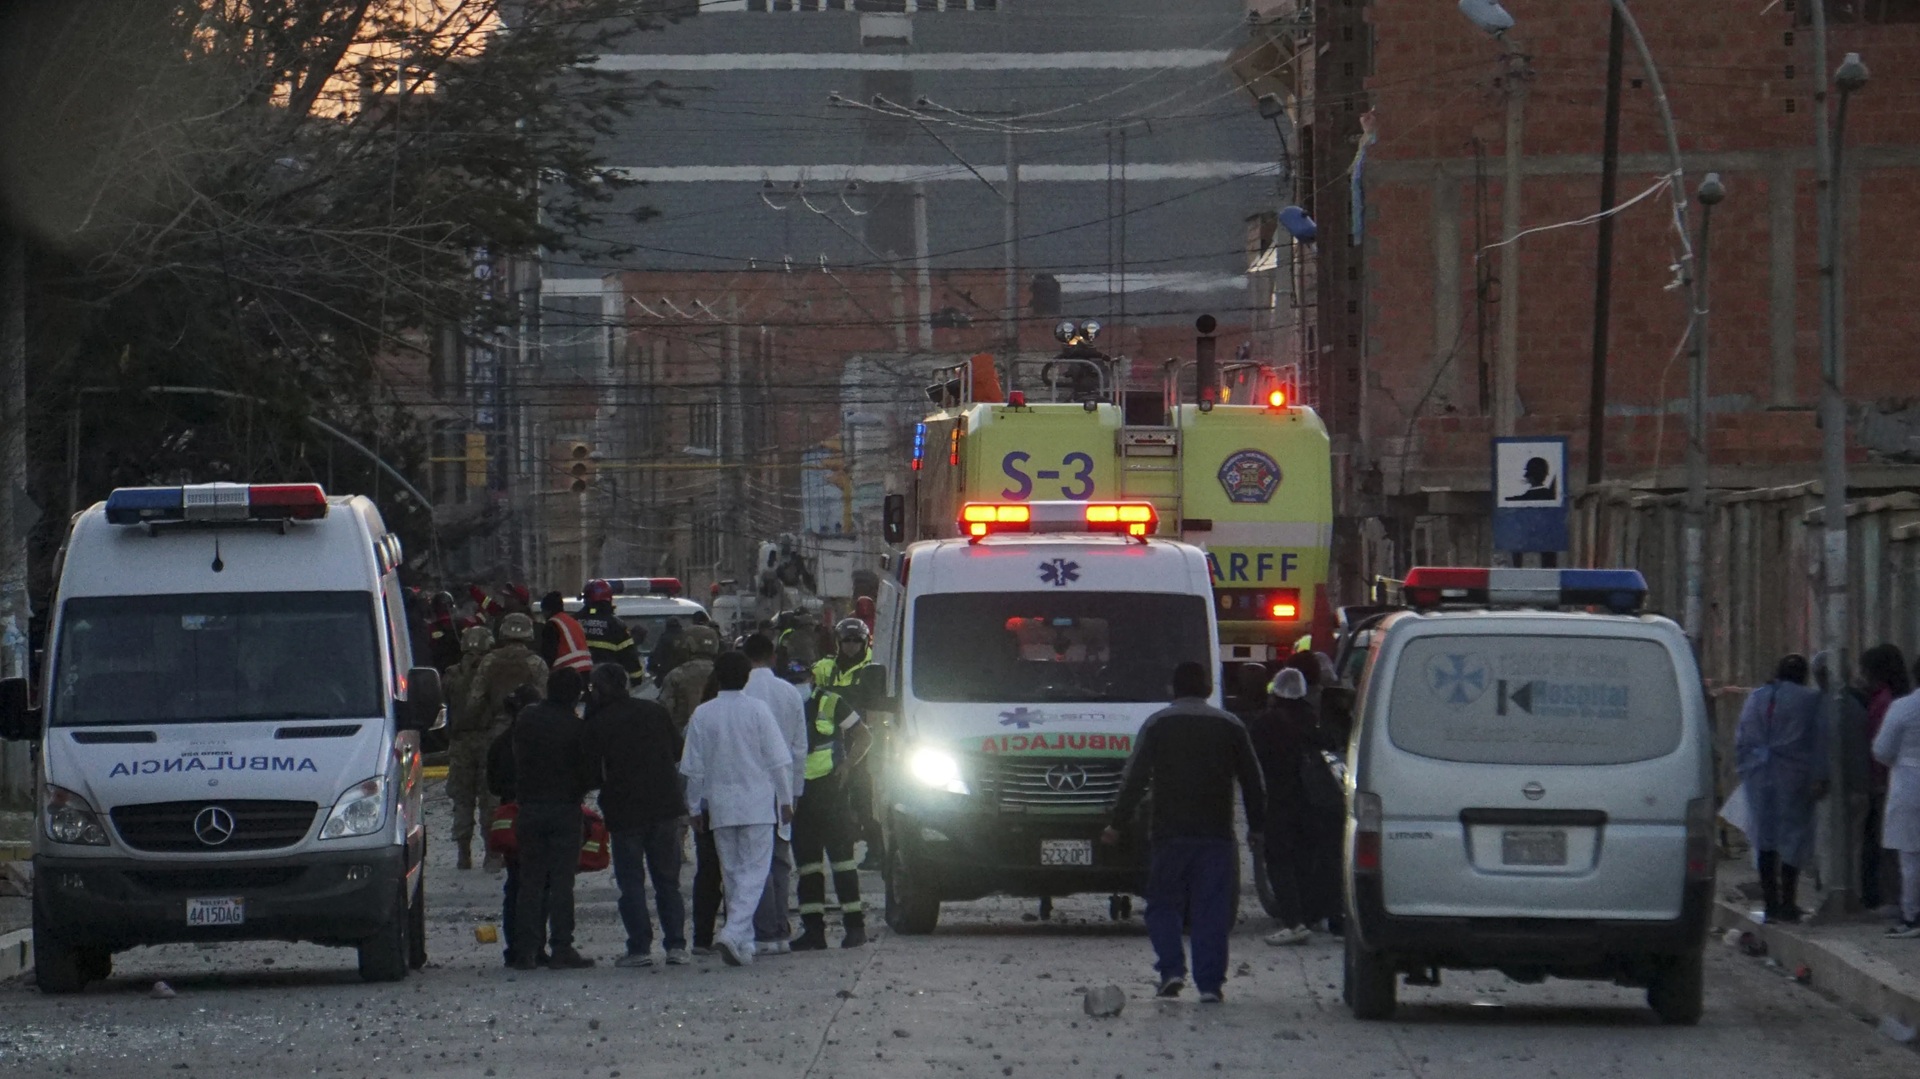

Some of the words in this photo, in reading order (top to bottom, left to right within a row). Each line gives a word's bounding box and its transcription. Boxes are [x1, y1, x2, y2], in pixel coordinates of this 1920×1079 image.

[1001, 451, 1095, 501] S-3
[1207, 552, 1298, 582] ARFF
[190, 906, 241, 922] 4415DAG
